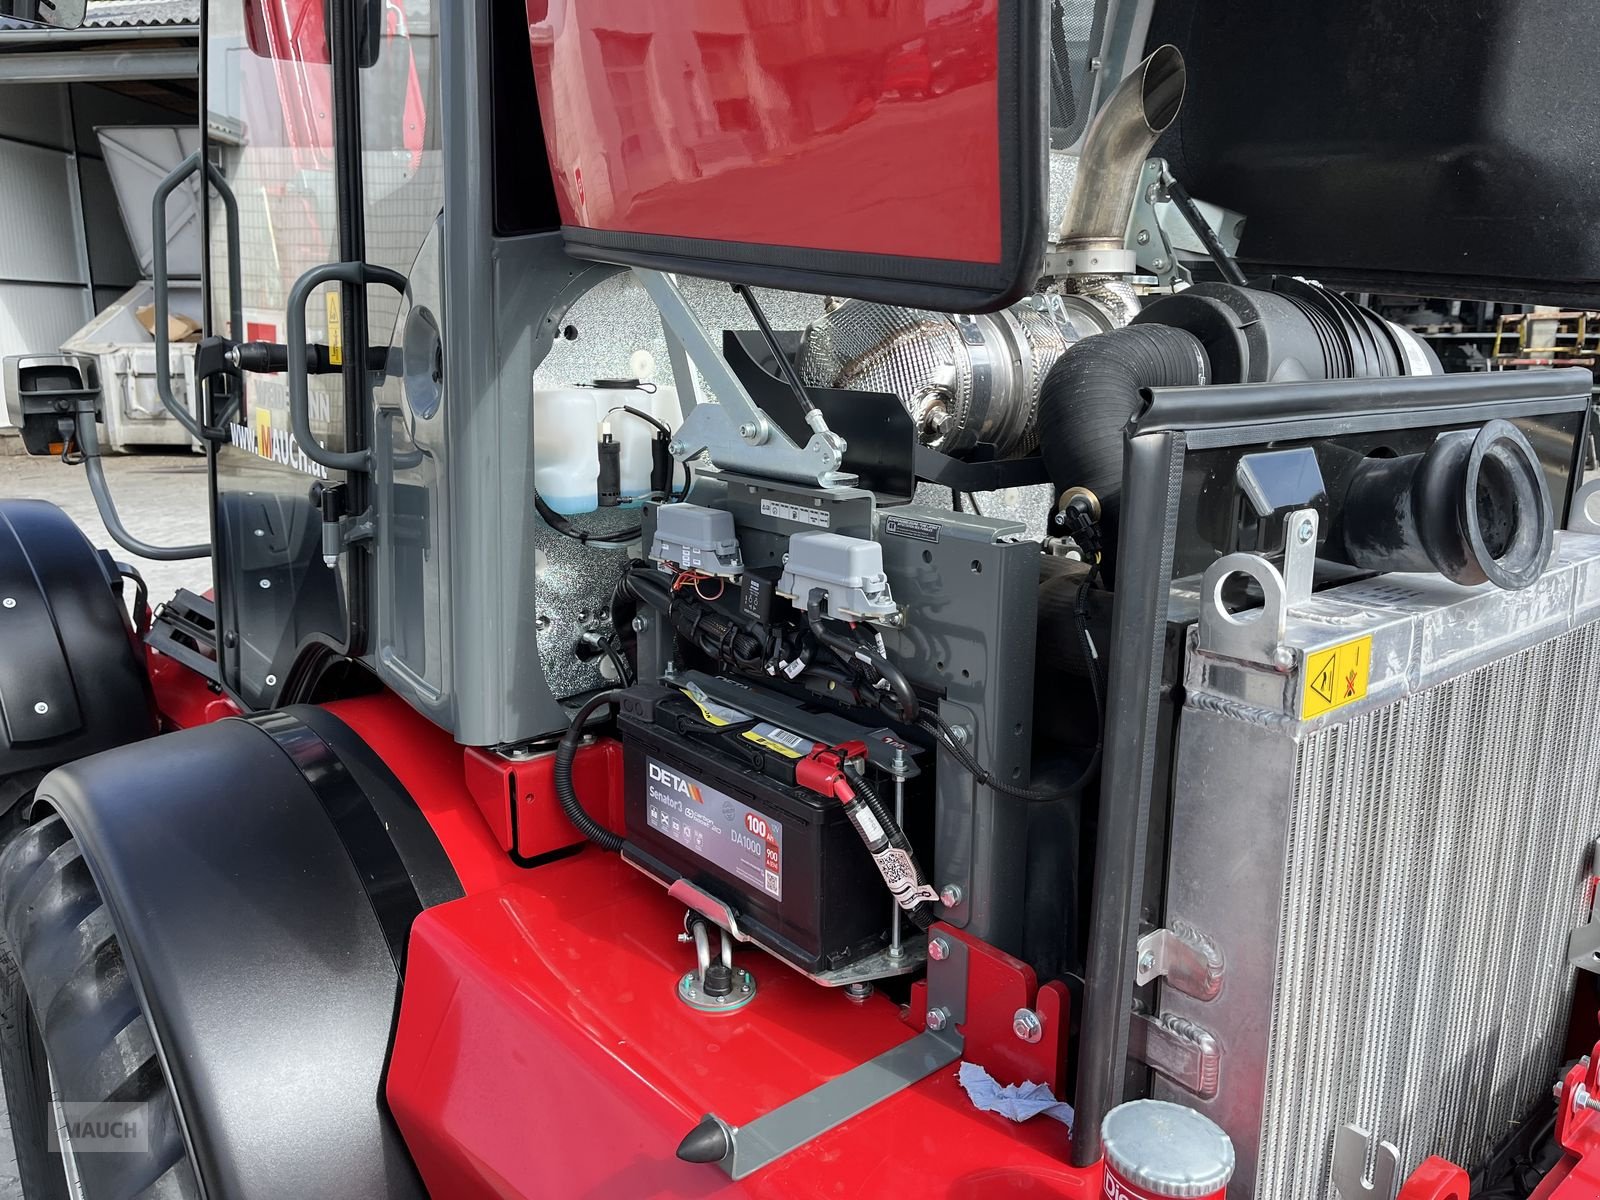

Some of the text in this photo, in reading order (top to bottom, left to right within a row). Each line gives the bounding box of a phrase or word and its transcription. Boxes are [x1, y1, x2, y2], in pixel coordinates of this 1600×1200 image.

[649, 762, 691, 798] DETA
[649, 785, 683, 813] Senator3
[746, 814, 767, 838] 100
[730, 828, 761, 856] DA1000
[766, 848, 778, 862] 900
